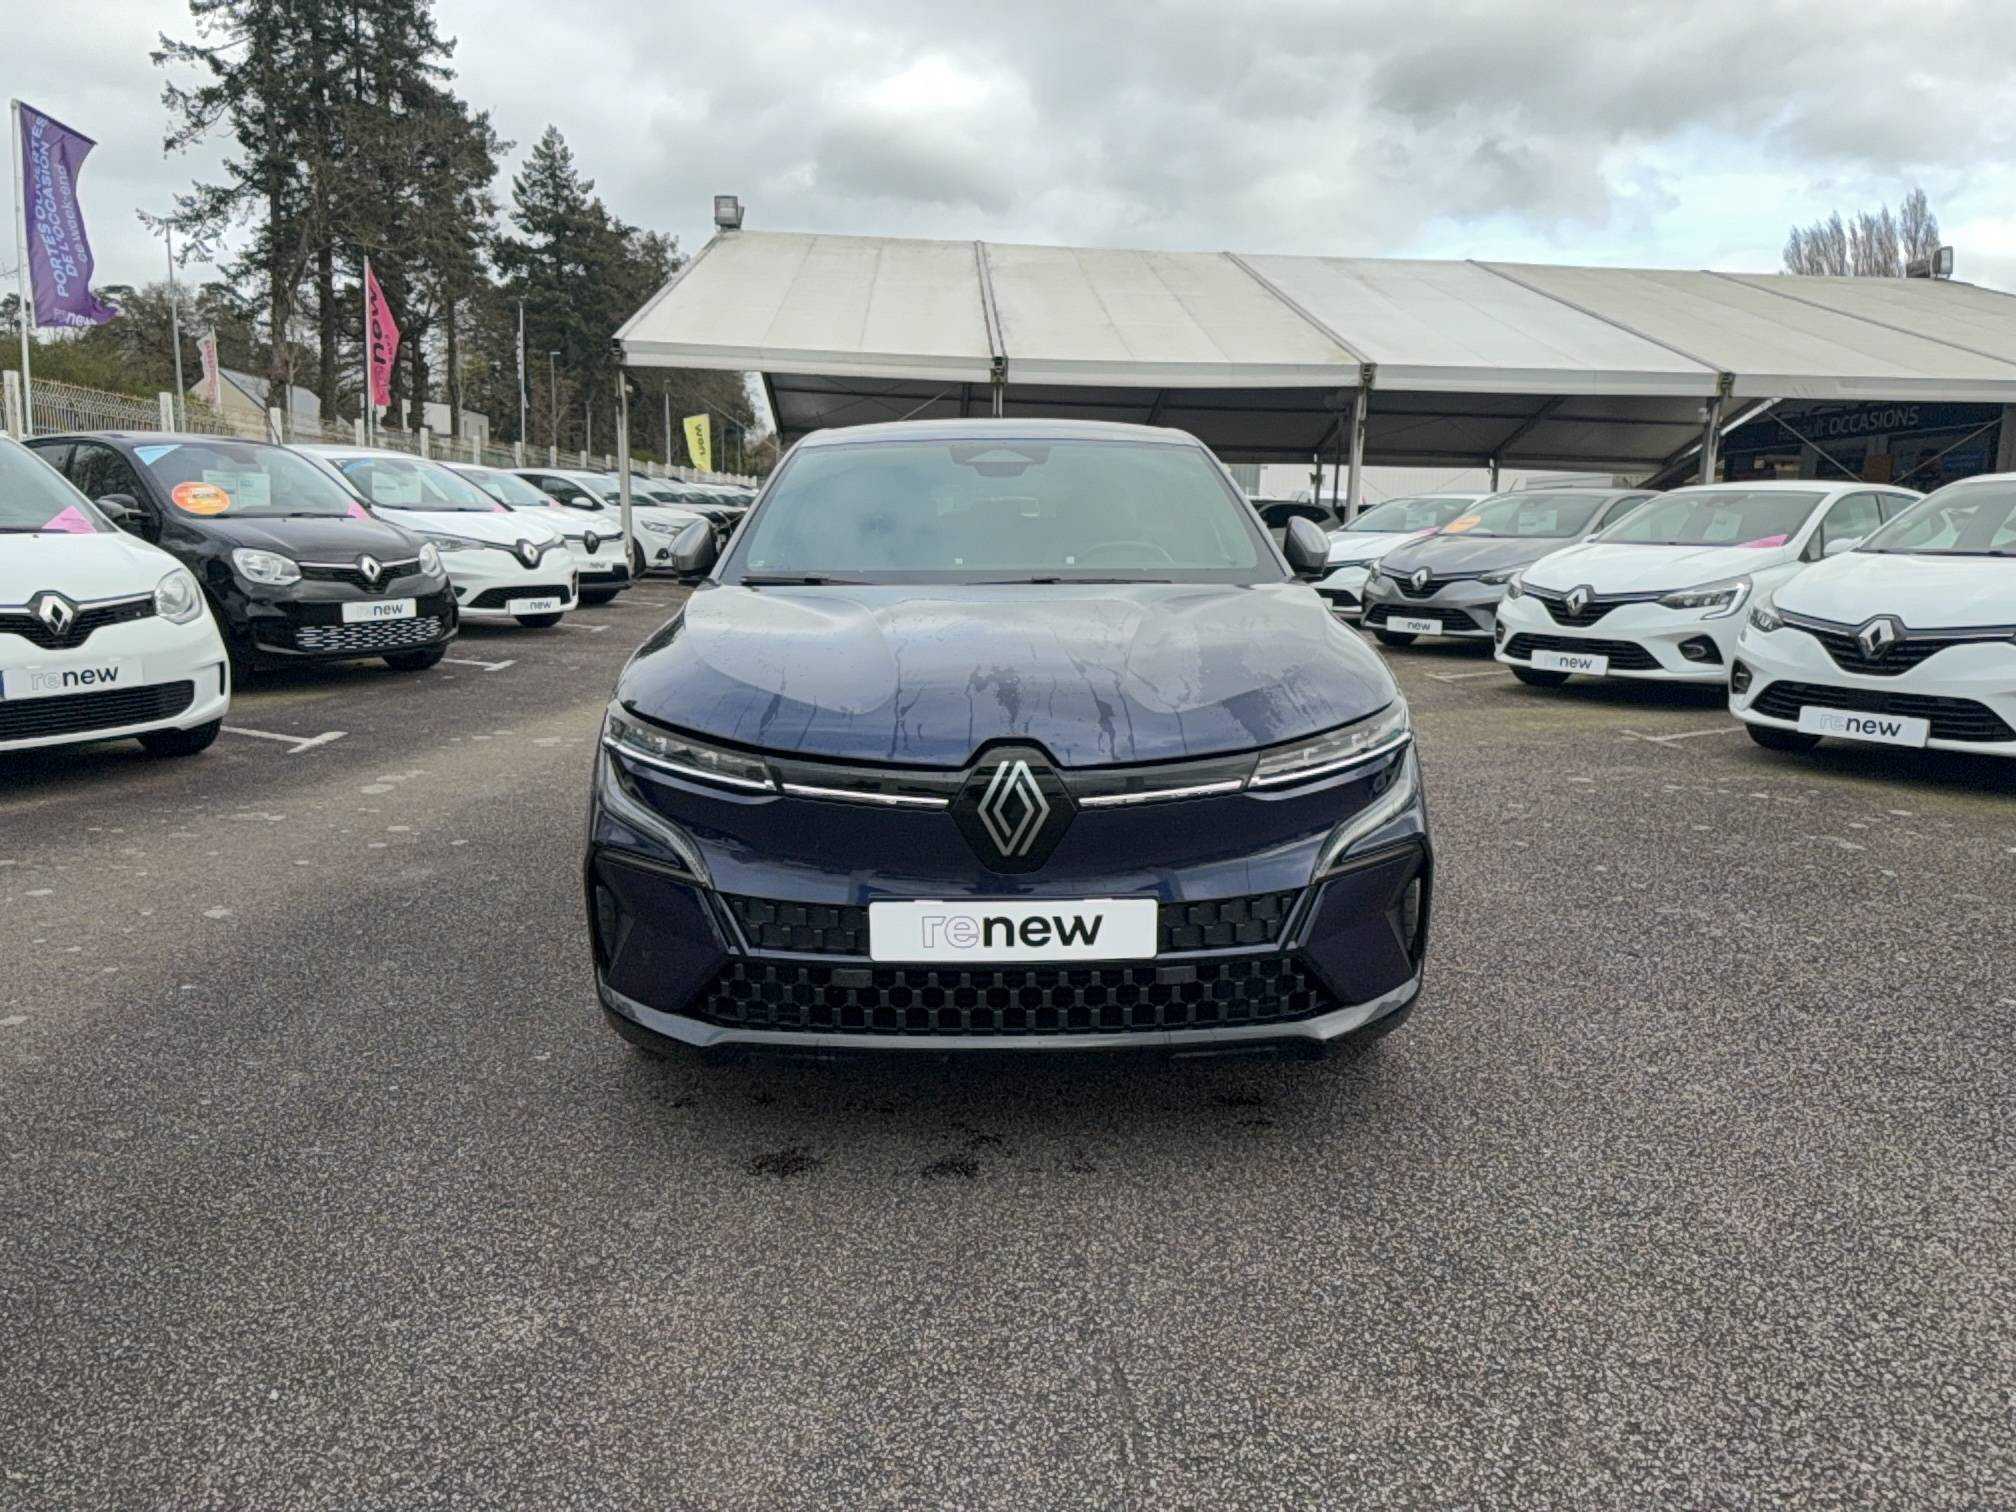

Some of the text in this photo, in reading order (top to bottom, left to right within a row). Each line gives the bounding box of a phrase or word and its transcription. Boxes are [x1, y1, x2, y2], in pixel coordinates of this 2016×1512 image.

[37, 222, 69, 297] PORTES
[61, 253, 79, 277] DE
[74, 243, 88, 263] ce
[1828, 406, 1920, 435] OCCASIONS
[32, 664, 119, 690] renew
[922, 915, 1103, 949] renew
